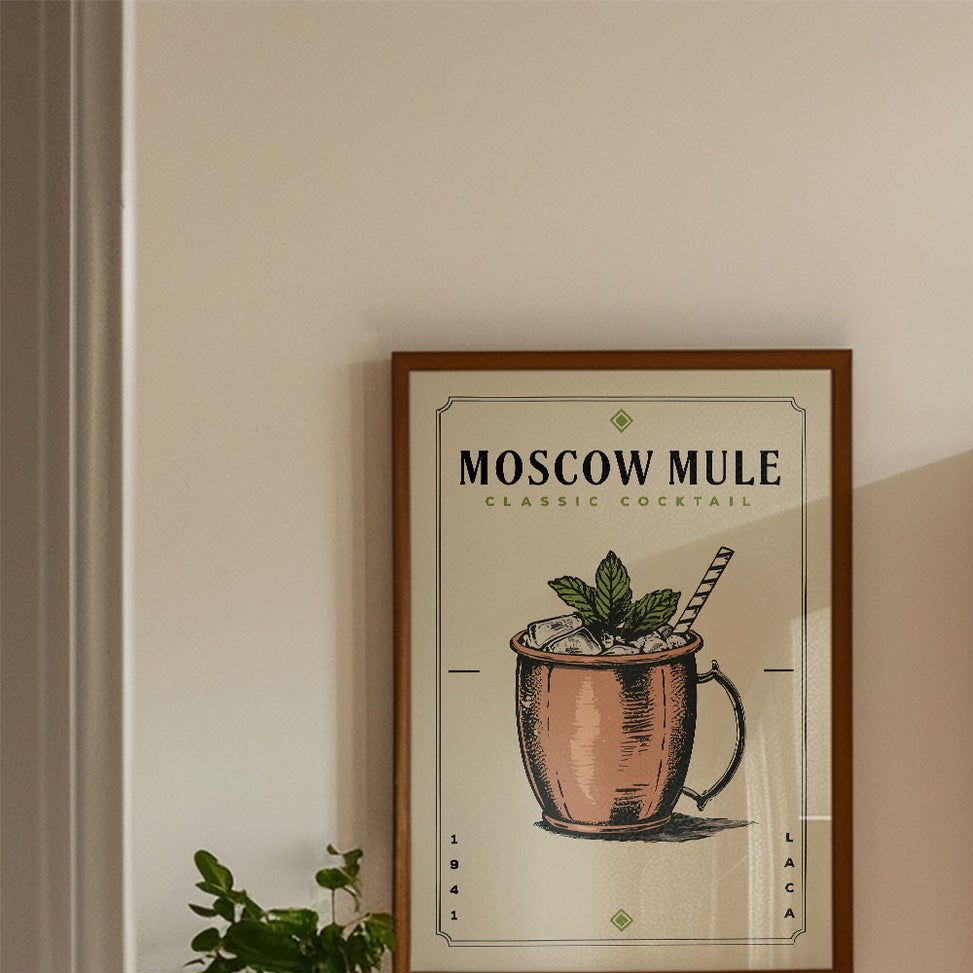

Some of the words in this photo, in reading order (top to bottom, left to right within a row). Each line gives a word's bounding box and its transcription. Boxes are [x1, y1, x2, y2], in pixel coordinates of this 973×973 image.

[459, 449, 654, 486] MOSCOW
[668, 449, 781, 486] MULE
[484, 496, 599, 508] CLASSIC
[620, 496, 752, 508] COCKTAIL
